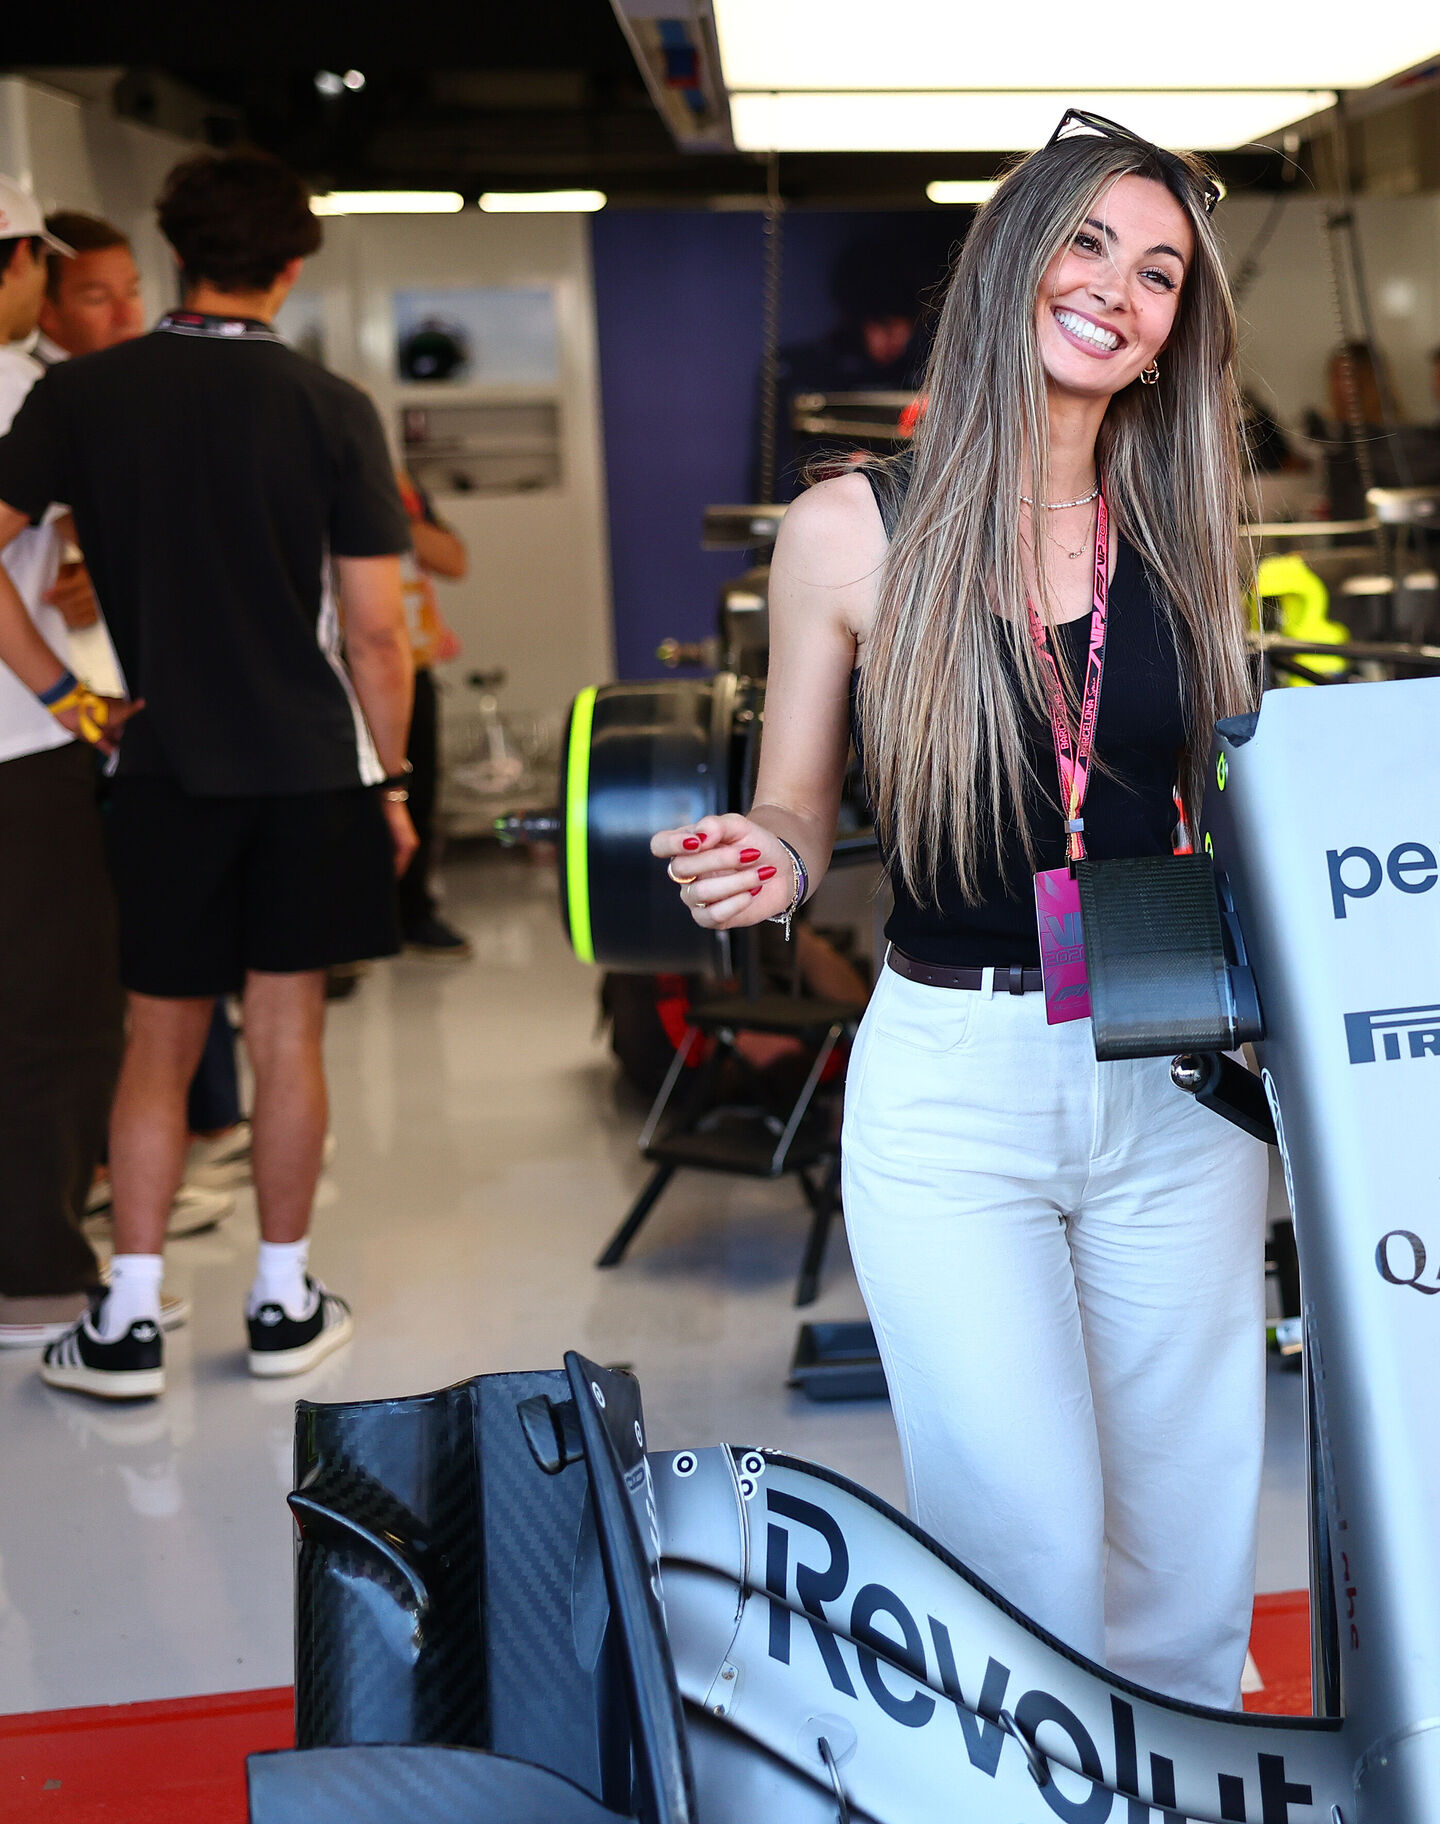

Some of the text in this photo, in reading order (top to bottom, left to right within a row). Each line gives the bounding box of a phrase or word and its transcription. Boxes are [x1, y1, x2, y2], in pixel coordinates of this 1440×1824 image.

[1097, 544, 1106, 565] VIP
[1079, 699, 1095, 757] BARCELONA
[766, 1487, 1313, 1824] Revolut
